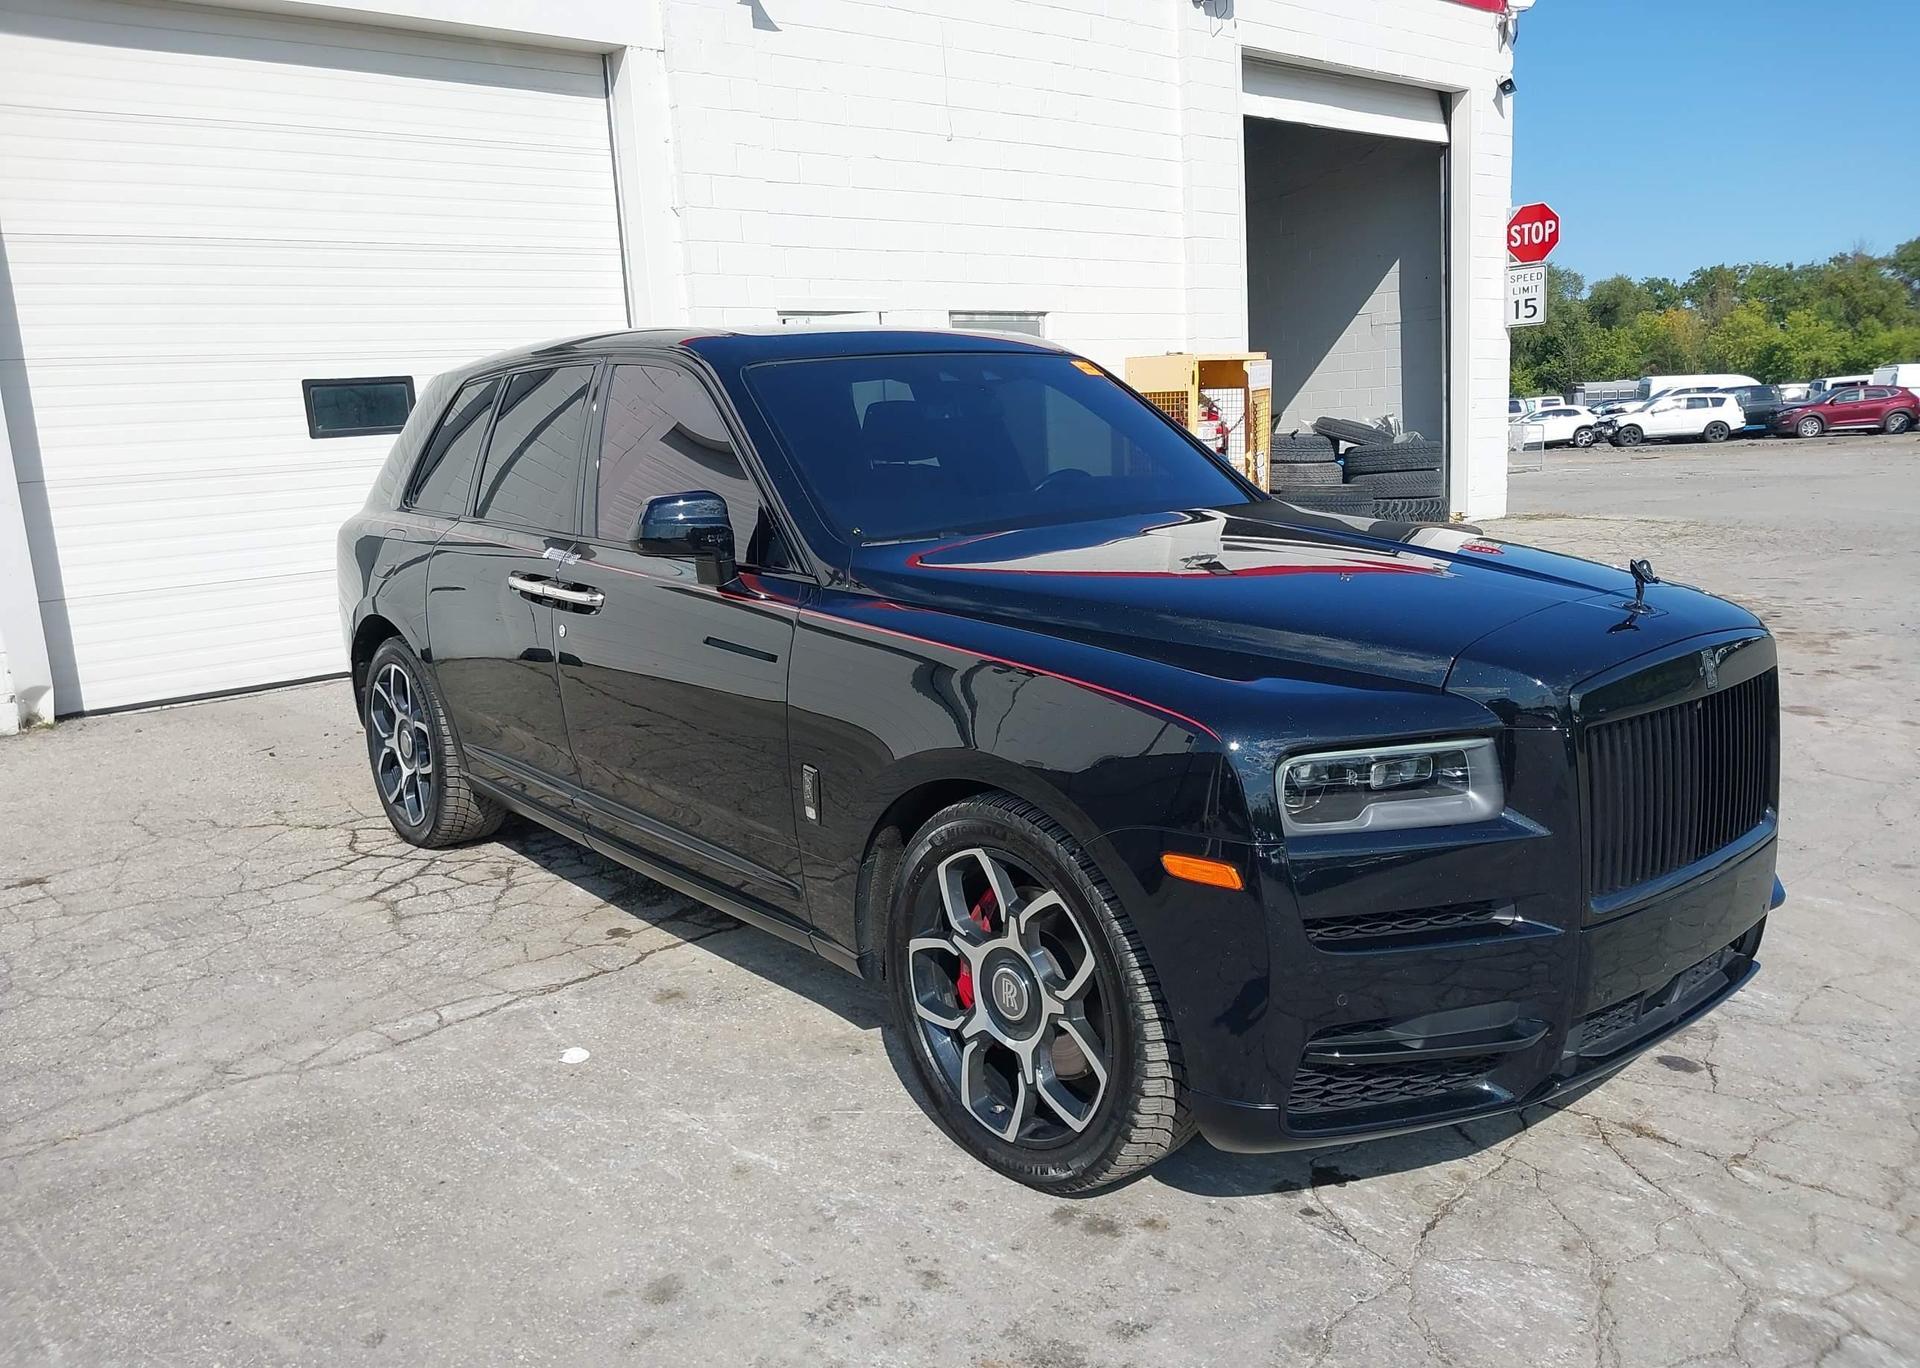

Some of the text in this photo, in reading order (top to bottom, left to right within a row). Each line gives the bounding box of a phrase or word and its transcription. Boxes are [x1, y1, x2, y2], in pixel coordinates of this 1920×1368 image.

[1510, 220, 1556, 247] STOP
[1510, 272, 1542, 283] SPEED
[1512, 285, 1539, 296] LIMIT
[1513, 298, 1538, 319] 15
[1002, 978, 1018, 1010] RR
